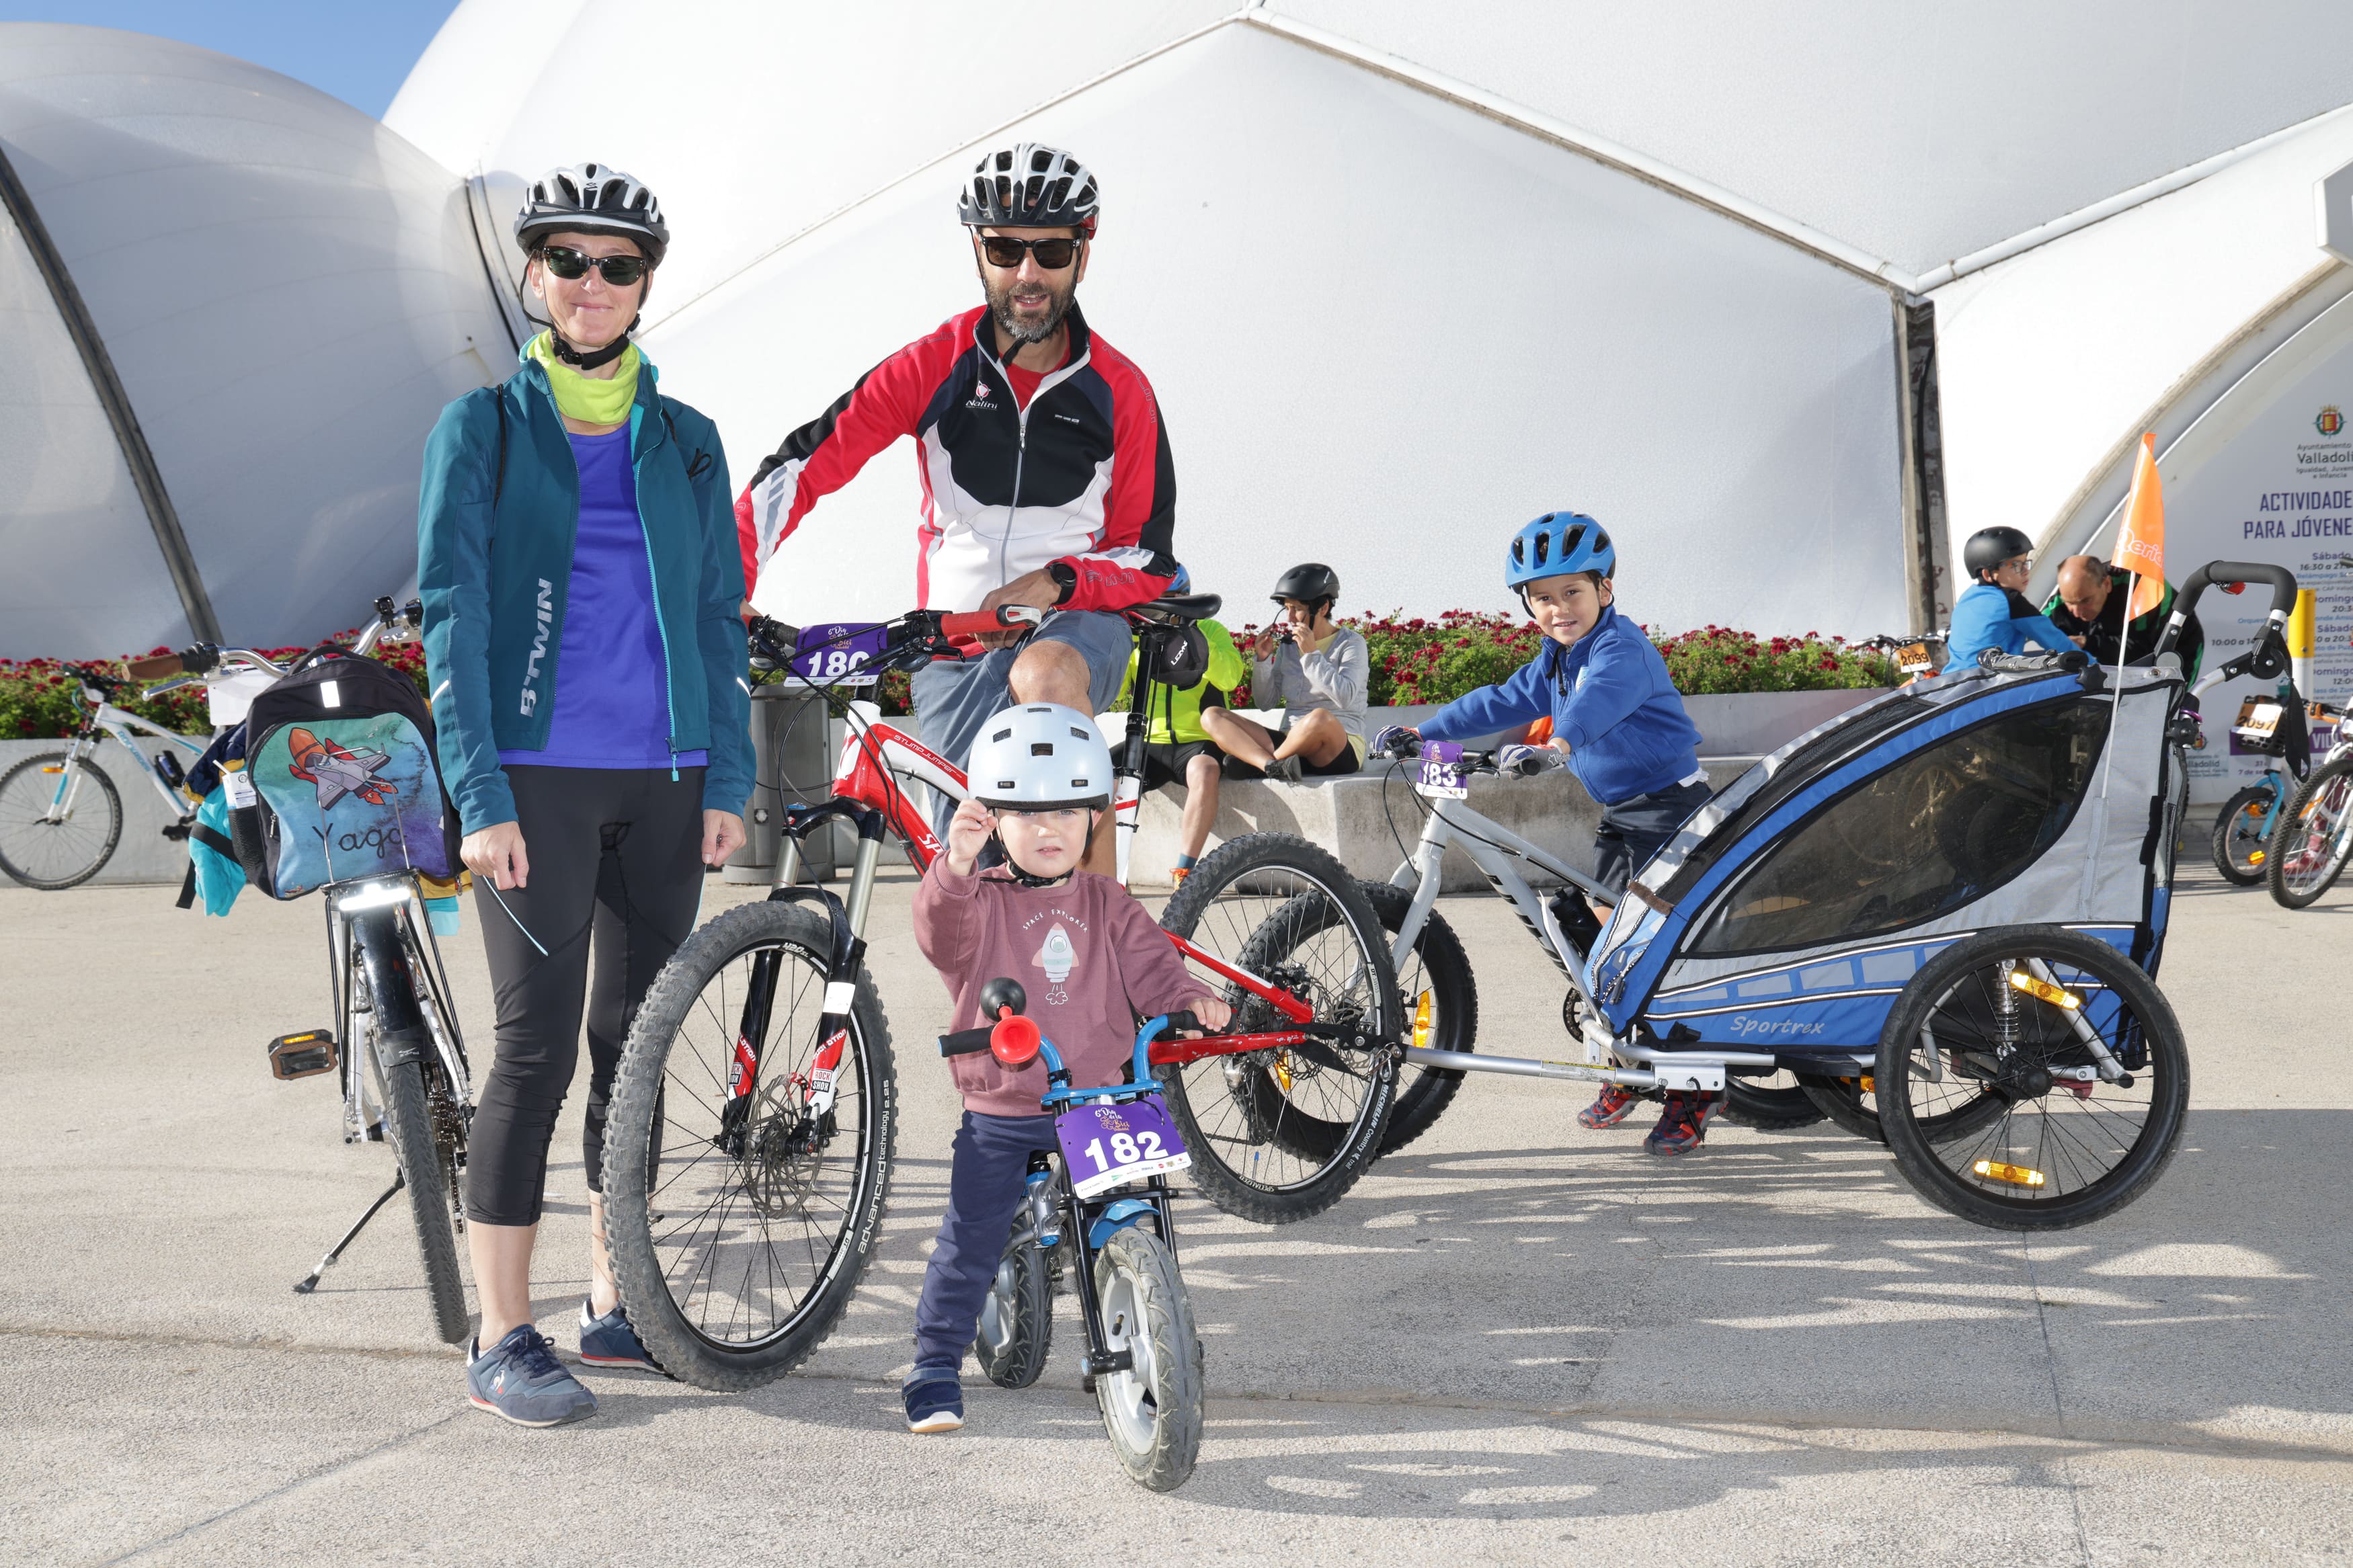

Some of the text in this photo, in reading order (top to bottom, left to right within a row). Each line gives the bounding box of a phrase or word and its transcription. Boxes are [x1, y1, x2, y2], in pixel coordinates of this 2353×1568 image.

[965, 400, 998, 409] Nalini
[2260, 491, 2352, 511] ACTIVIDADE
[2243, 515, 2353, 539] PARA JÓVENE
[808, 651, 871, 677] 180
[1901, 652, 1929, 666] 2099
[2237, 716, 2276, 731] 2097
[1423, 761, 1458, 787] 183
[1023, 909, 1088, 934] SPACE EXPLORER
[1730, 1016, 1825, 1038] Sportrex
[812, 1081, 830, 1091] SHOX
[814, 1071, 830, 1081] ROCK
[1371, 1083, 1390, 1129] MICHELIN
[1084, 1131, 1169, 1173] 182
[1356, 1128, 1375, 1153] Country
[858, 1161, 887, 1255] advanced
[879, 1110, 890, 1161] technology
[1238, 1174, 1275, 1193] SPECIALIZED
